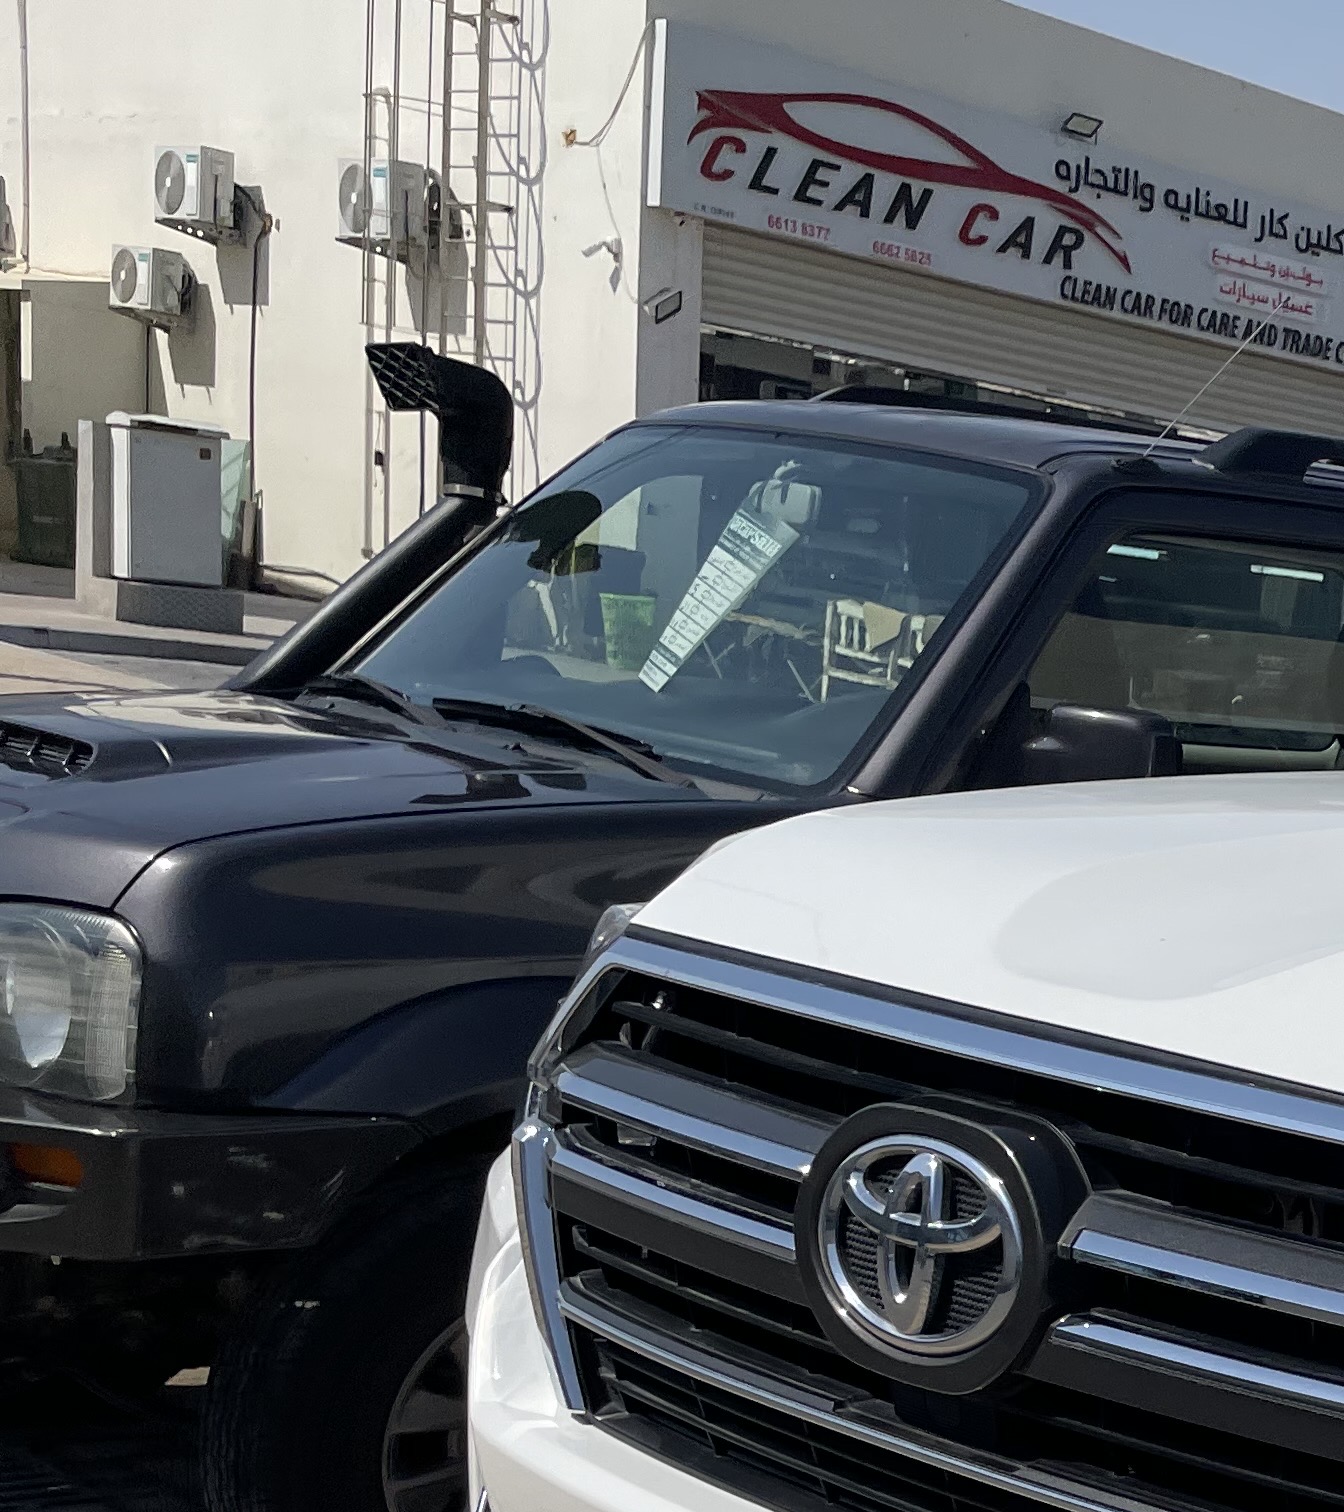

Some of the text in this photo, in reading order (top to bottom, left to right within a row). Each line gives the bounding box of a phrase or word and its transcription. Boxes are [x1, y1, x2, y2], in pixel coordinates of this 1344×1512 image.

[699, 135, 1086, 270] CLEAN CAR
[1054, 155, 1156, 213] والتجاره
[1254, 207, 1291, 243] كار
[1060, 274, 1118, 311] CLEAN
[1120, 289, 1156, 320] CAR
[1157, 297, 1194, 329] FOR
[1197, 307, 1241, 339] CARE
[1241, 318, 1279, 347] AND
[1280, 326, 1334, 361] TRADE
